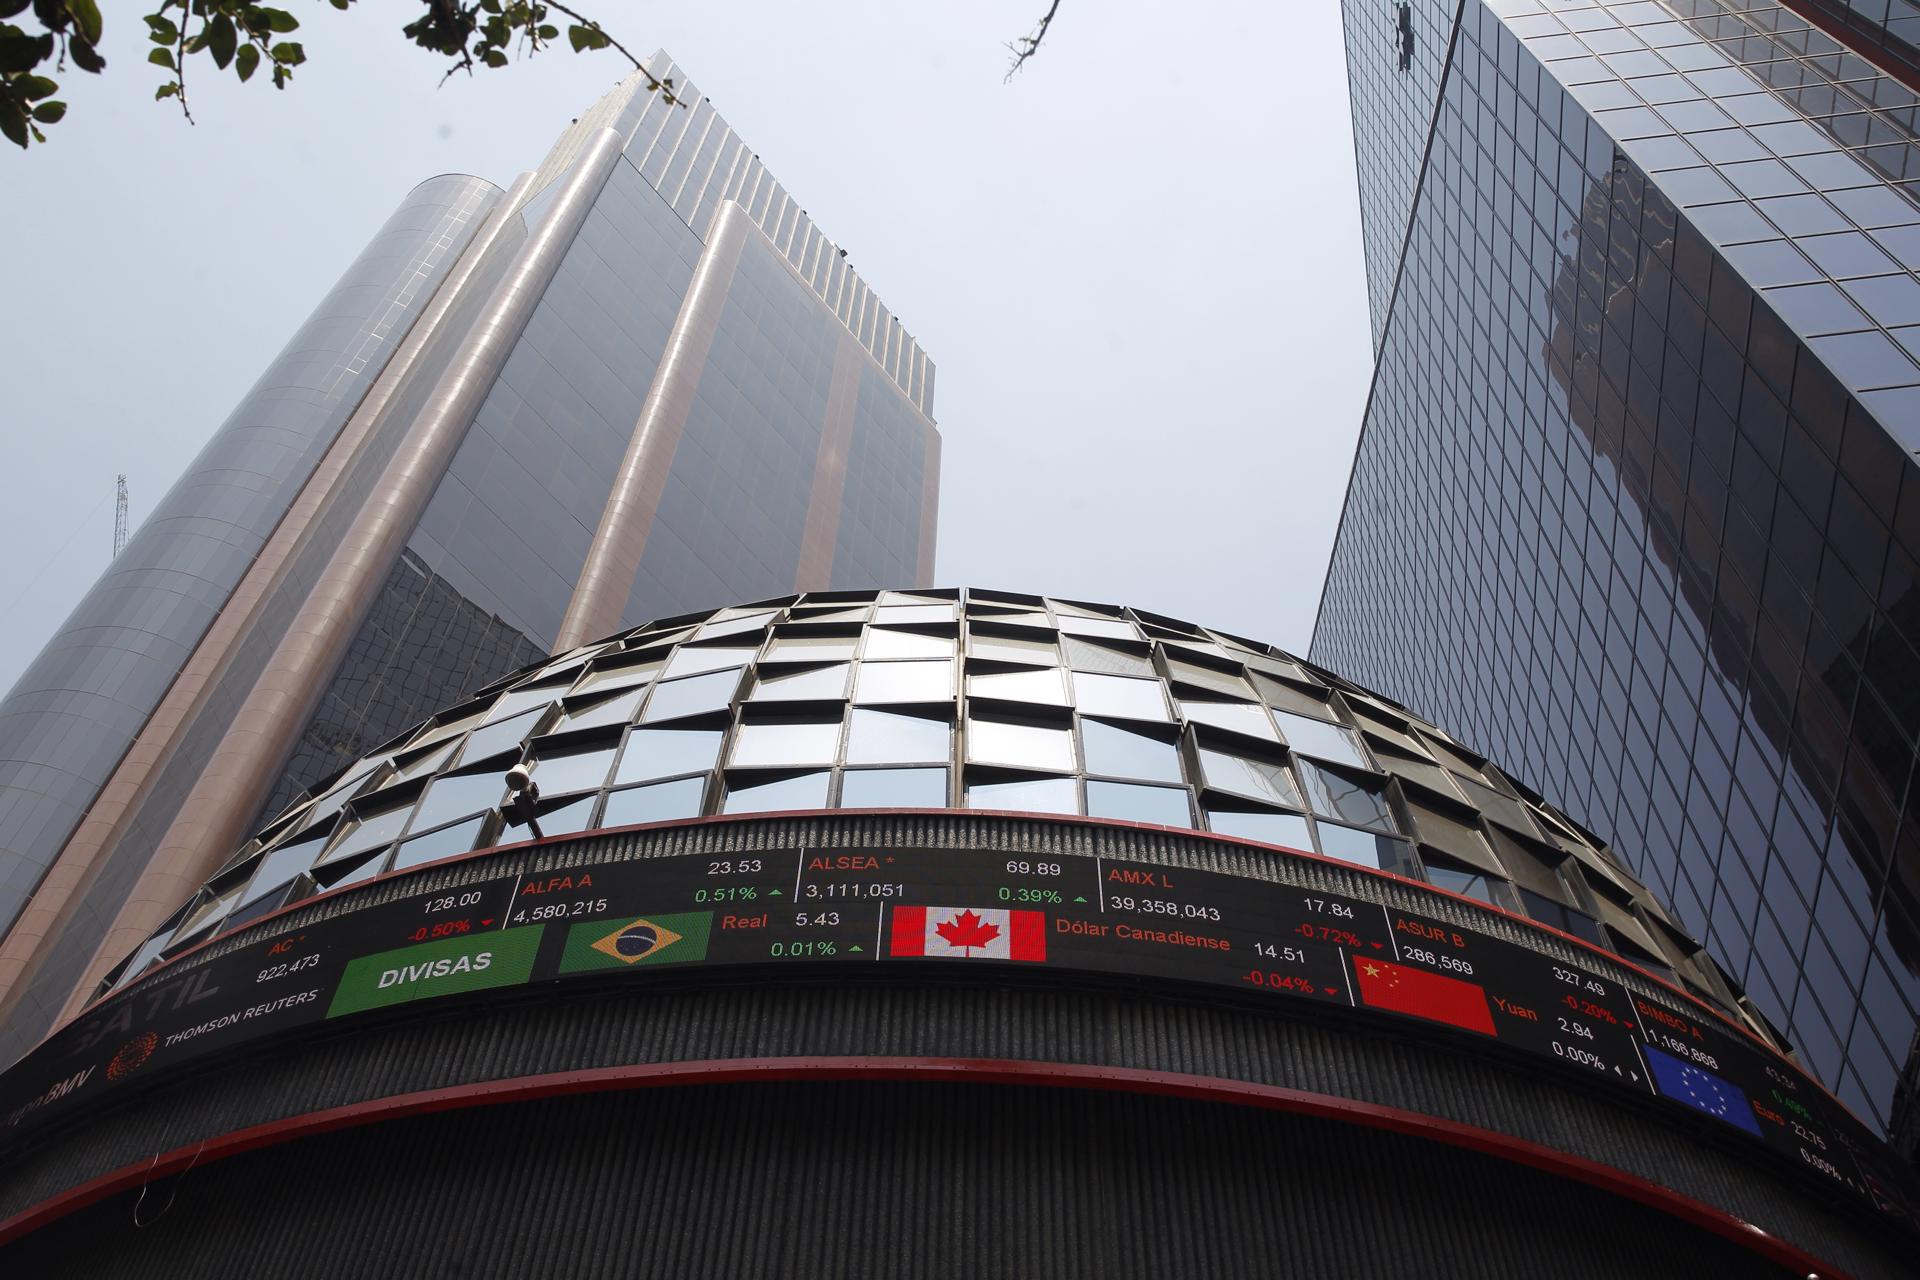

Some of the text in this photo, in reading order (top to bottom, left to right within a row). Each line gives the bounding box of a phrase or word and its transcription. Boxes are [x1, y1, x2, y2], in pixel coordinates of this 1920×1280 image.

[706, 859, 763, 875] 23.53
[808, 856, 880, 870] ALSEA
[1005, 860, 1062, 877] 69.89
[521, 873, 593, 896] ALFA A
[1108, 868, 1175, 889] AMX L
[423, 891, 482, 915] 128.00
[694, 886, 757, 904] 0.51%
[805, 883, 904, 900] 3,111,051
[998, 887, 1063, 905] 0.39%
[513, 898, 608, 924] 4,580,215
[795, 912, 840, 927] 5.43
[1110, 895, 1221, 922] 39,358,043
[1303, 898, 1354, 920] 17.84
[407, 919, 471, 942] -0.50%
[722, 913, 767, 930] Real
[1396, 918, 1465, 948] ASUR B
[1056, 918, 1231, 951] Dólar Canadiense
[1295, 922, 1362, 949] -0.72%
[770, 941, 837, 957] 0.01%
[1254, 942, 1305, 964] 14.51
[1403, 945, 1474, 976] 286,569
[256, 953, 320, 983] 922,473
[377, 951, 492, 989] DIVISAS
[1242, 970, 1315, 995] -0.04%
[1552, 966, 1606, 997] 327.49
[164, 989, 319, 1047] THOMSON REUTERS
[1492, 995, 1538, 1022] Yuan
[1557, 1017, 1594, 1041] 2.94
[1552, 1040, 1606, 1071] 0.00%
[1649, 1029, 1719, 1070] 1,166,868
